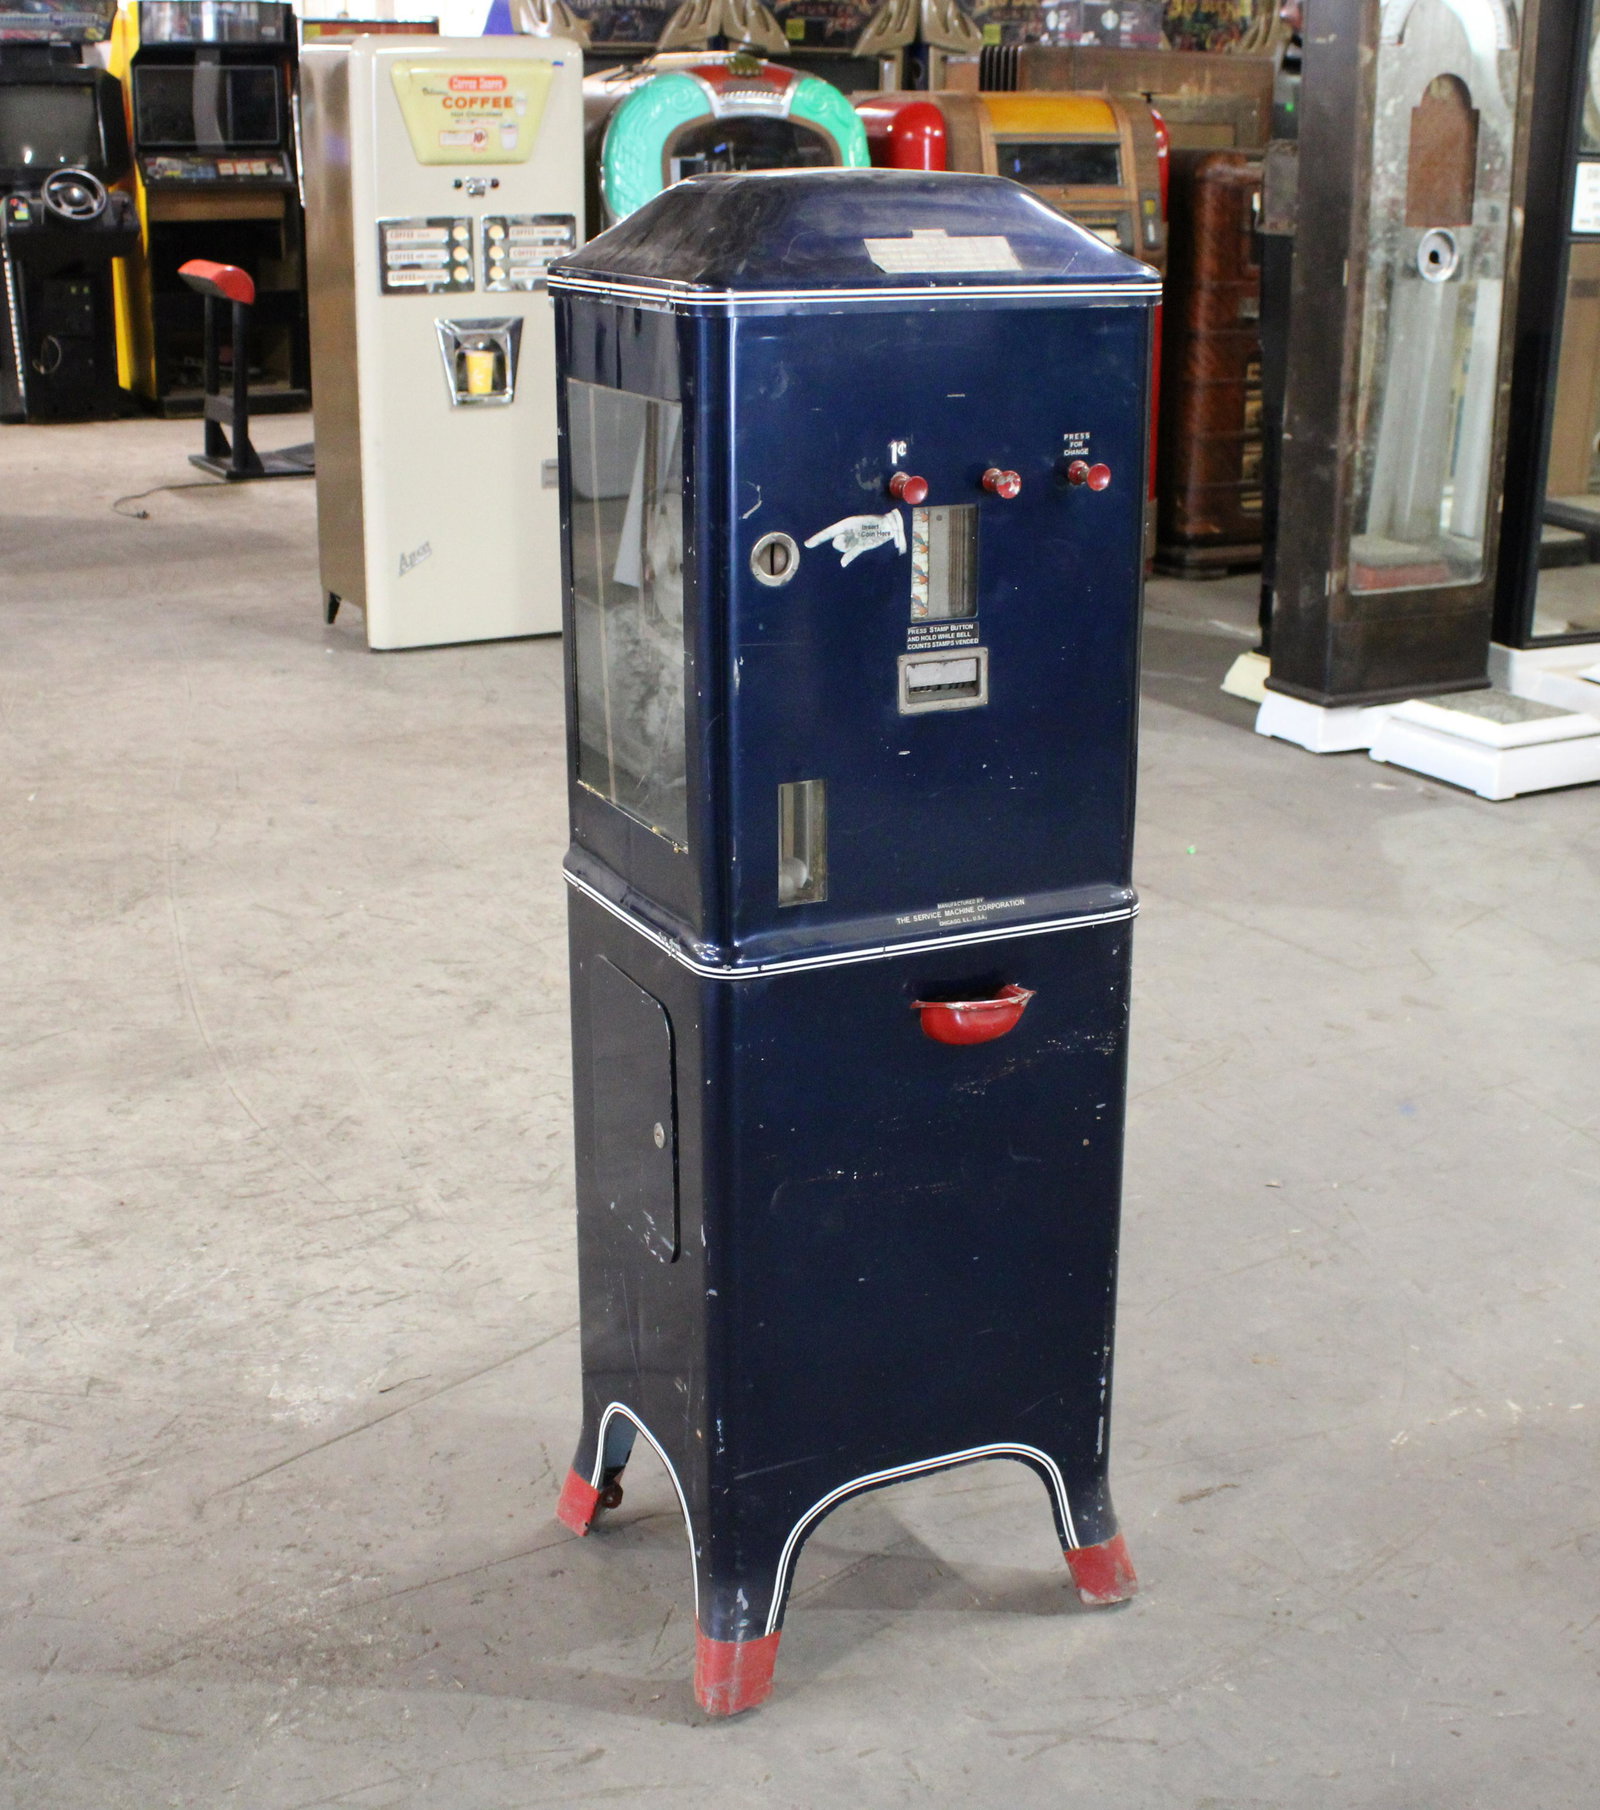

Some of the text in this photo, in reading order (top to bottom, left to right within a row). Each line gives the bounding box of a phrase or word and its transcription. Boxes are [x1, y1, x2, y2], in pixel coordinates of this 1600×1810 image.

[442, 96, 514, 109] COFFEE
[1064, 432, 1090, 440] PRESS
[889, 441, 907, 464] 1¢
[1064, 448, 1089, 456] CHANGE
[907, 642, 932, 650] COUNTS
[937, 899, 975, 909] MANUFACTURED
[913, 911, 942, 922] SERVICE
[944, 906, 975, 916] MACHINE
[977, 898, 1025, 912] CORPORATION
